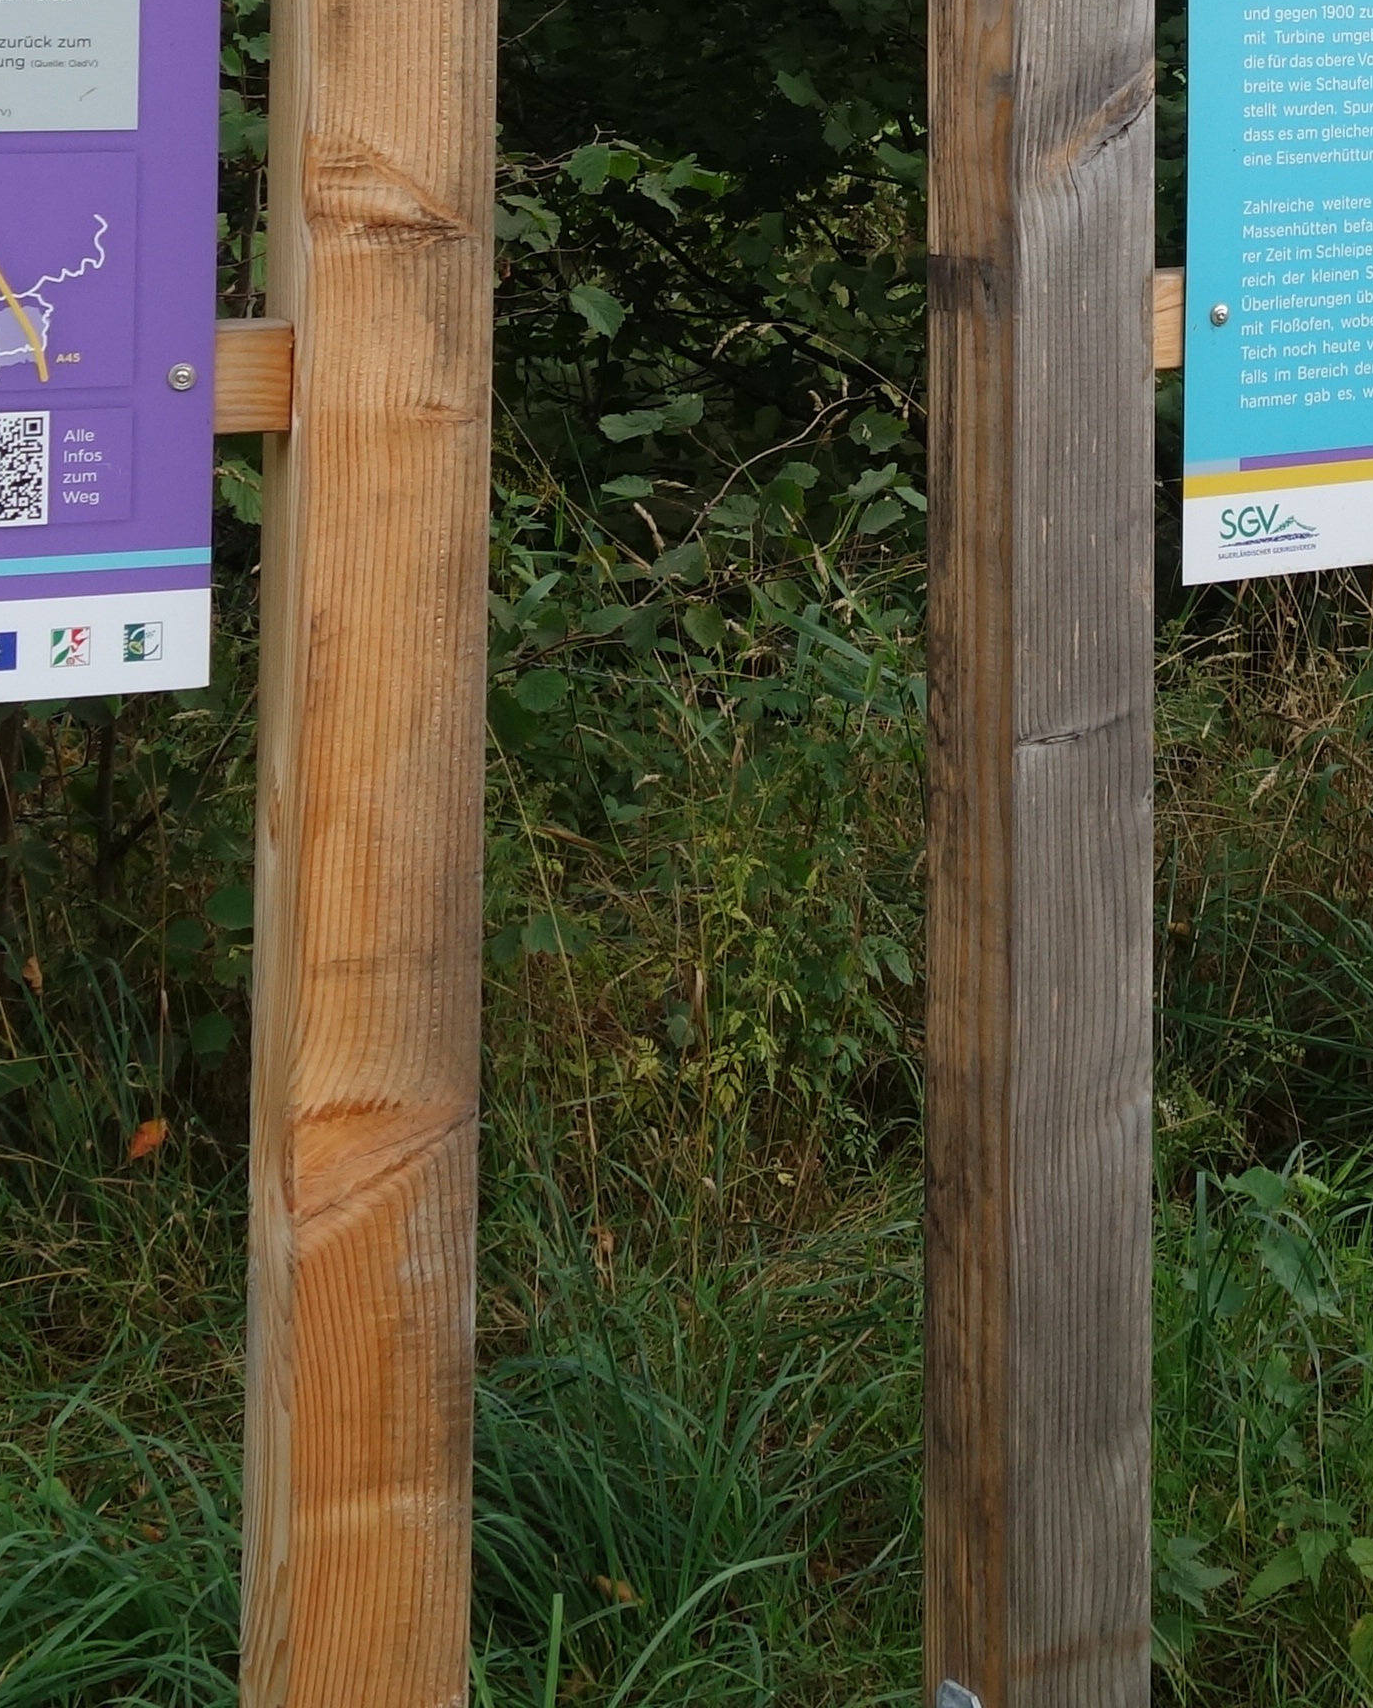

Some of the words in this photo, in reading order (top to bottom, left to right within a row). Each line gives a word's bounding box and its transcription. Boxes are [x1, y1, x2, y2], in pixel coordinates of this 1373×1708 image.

[1244, 6, 1269, 20] und
[1275, 9, 1317, 22] gegen
[1322, 5, 1354, 20] 1900
[1359, 8, 1373, 18] zu
[57, 38, 91, 48] zum
[1243, 198, 1314, 214] Zahlreiche
[1322, 196, 1371, 210] weitere
[56, 353, 81, 364] A45
[63, 429, 95, 442] Alle
[63, 449, 102, 463] Infos
[63, 472, 97, 484] zum
[63, 490, 99, 506] Weg
[1219, 504, 1280, 540] SGV
